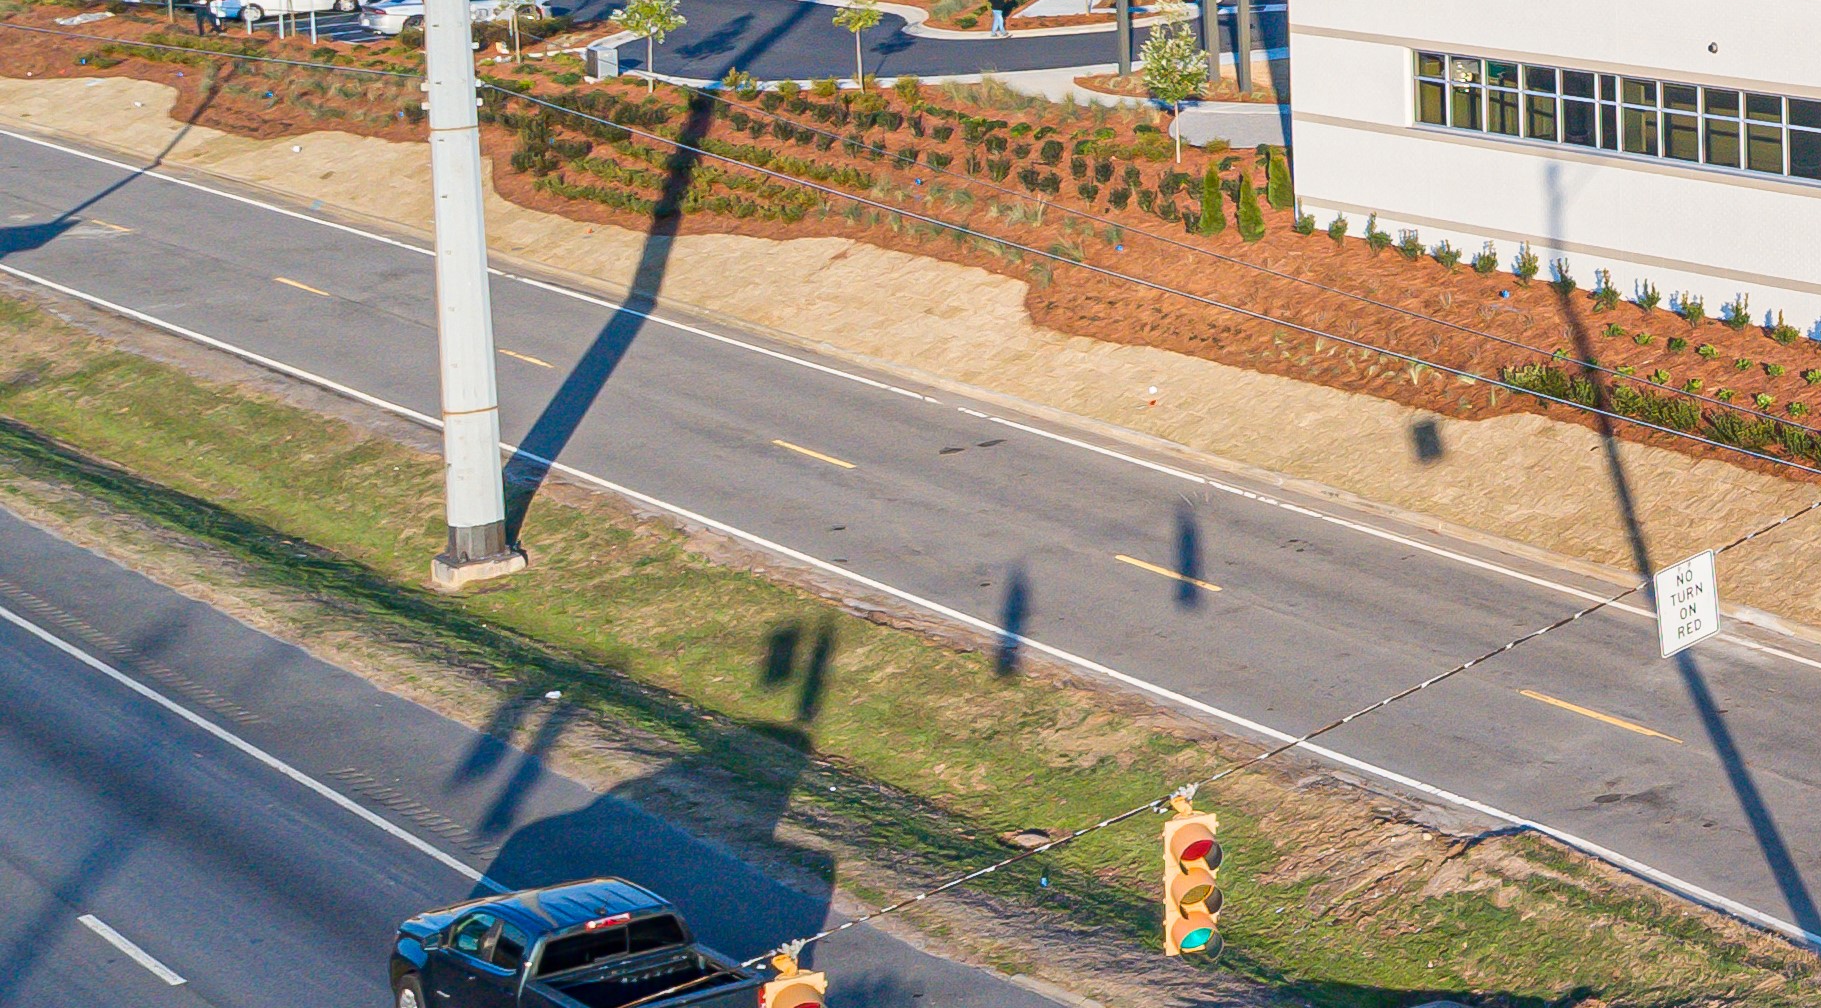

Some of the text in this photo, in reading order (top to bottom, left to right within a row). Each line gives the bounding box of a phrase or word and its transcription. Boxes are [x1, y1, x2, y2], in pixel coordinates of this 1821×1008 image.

[1676, 569, 1692, 586] NO
[1670, 582, 1703, 606] TURN
[1680, 602, 1696, 620] ON
[1678, 618, 1702, 639] RED
